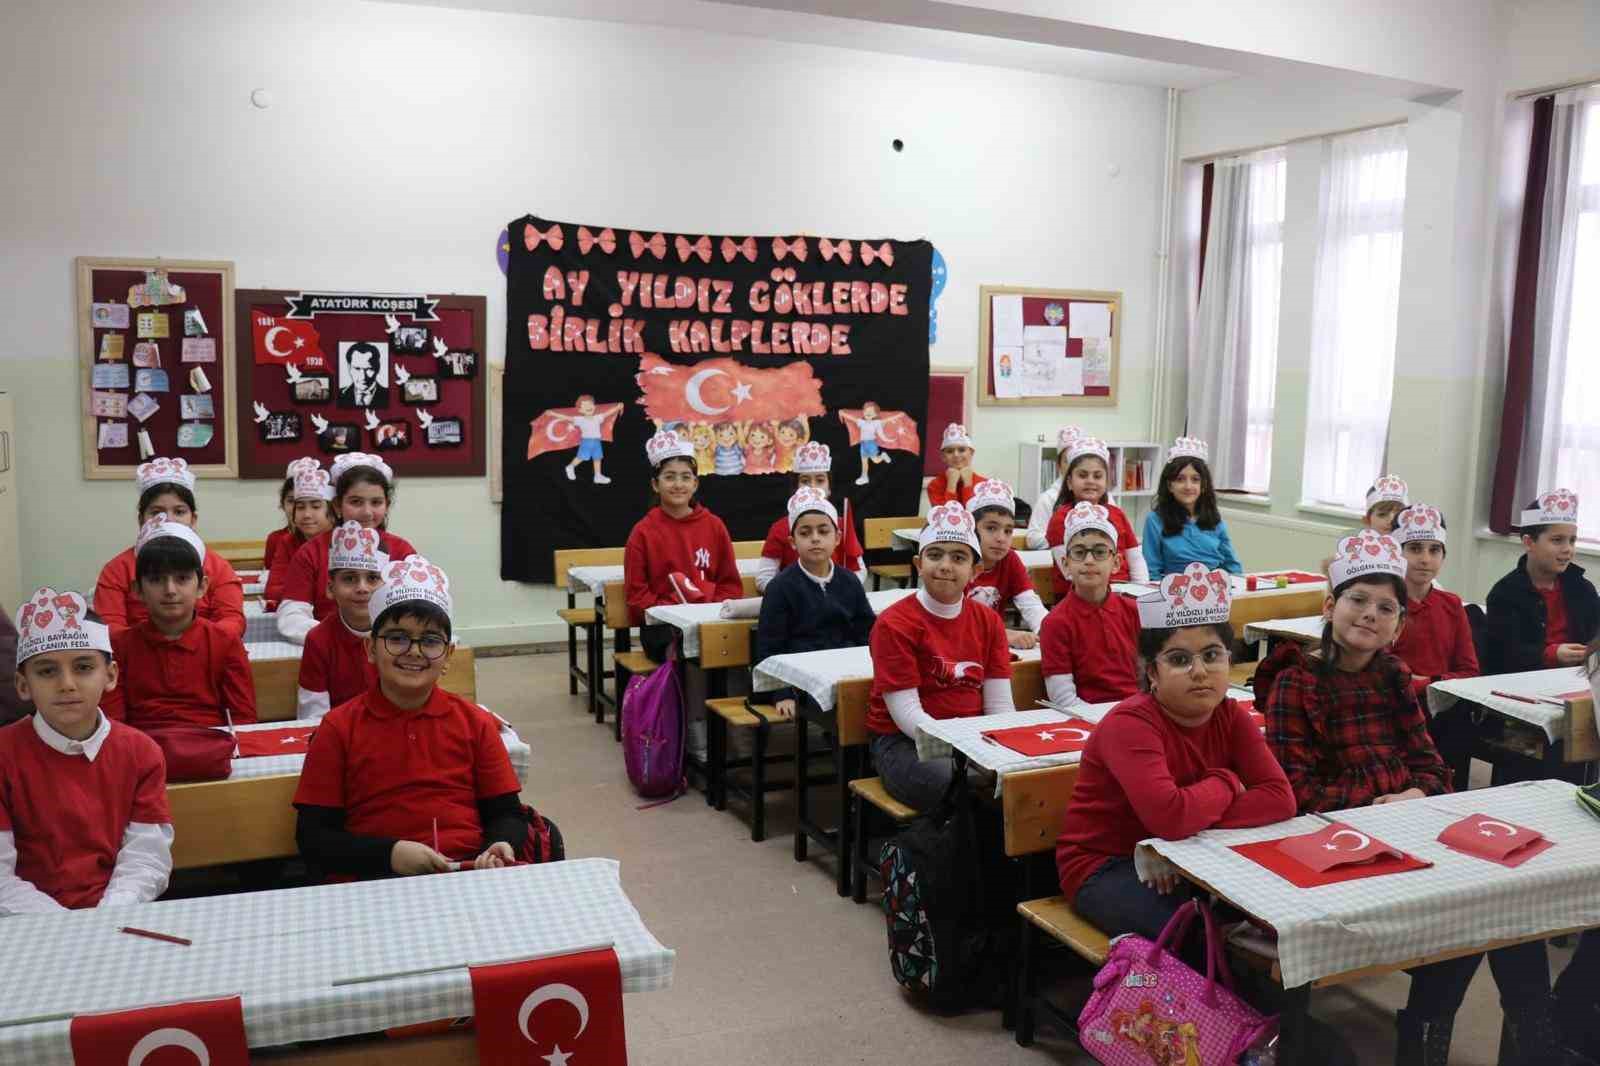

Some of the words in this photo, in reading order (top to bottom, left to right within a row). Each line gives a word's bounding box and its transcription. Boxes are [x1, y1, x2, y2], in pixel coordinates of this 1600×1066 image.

[543, 265, 590, 306] AY
[617, 270, 734, 314] YILDIZ
[749, 267, 909, 316] GÖKLERDE
[310, 298, 368, 310] ATATÜRK
[372, 298, 417, 312] KÖŞESİ
[527, 304, 646, 353] BİRLİK
[668, 318, 852, 355] KALPLERDE
[1176, 608, 1203, 618] YILDIZLI
[47, 629, 89, 642] BAYRAĞIM
[40, 640, 69, 651] CANIM
[71, 639, 91, 649] FEDA
